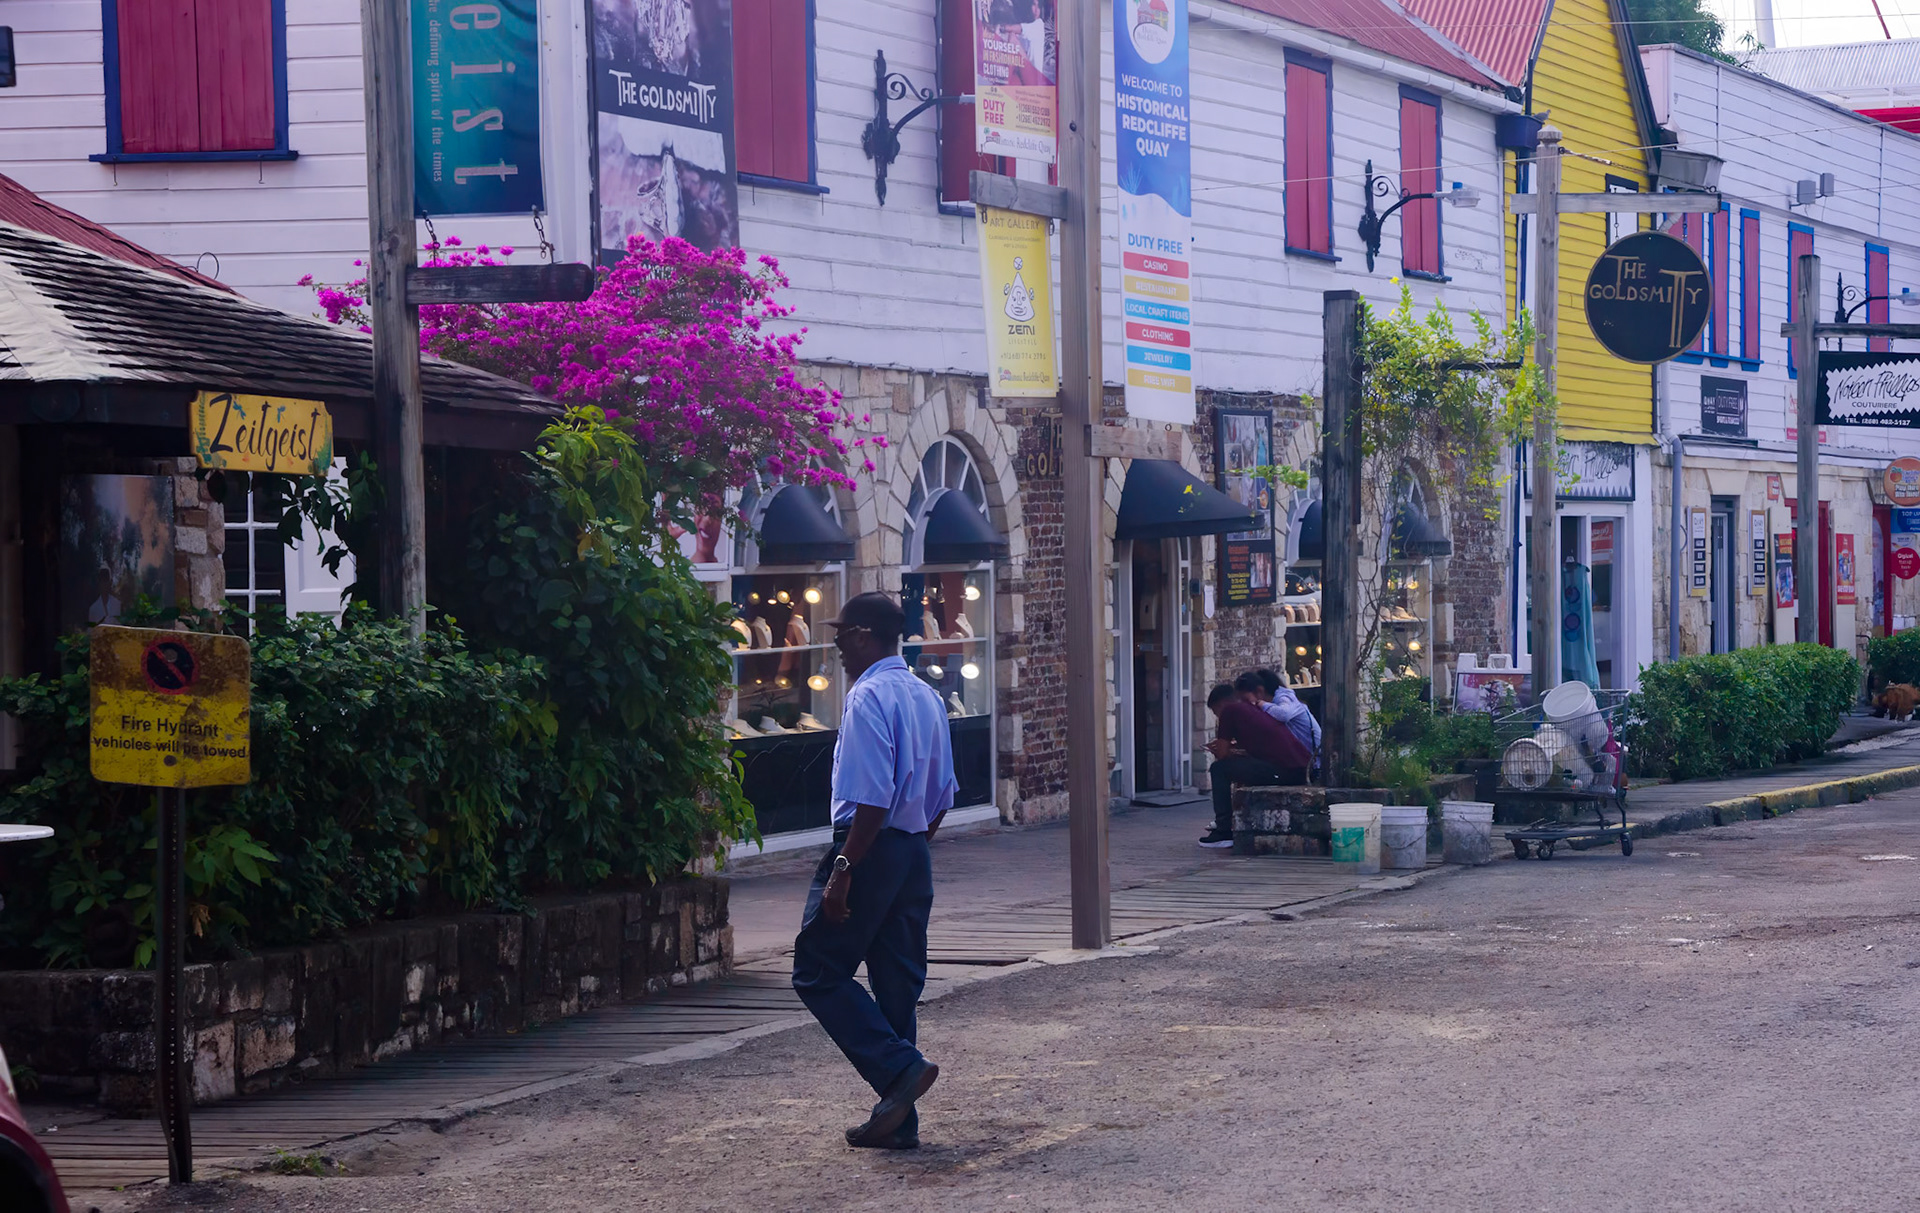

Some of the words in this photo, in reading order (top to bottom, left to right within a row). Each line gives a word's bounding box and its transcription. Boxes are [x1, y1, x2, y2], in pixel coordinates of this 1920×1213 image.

[427, 20, 441, 66] defining
[983, 38, 1020, 54] YOURSELF
[983, 62, 1009, 78] CLOTHING
[428, 72, 443, 103] spirit
[450, 4, 519, 185] eist
[1121, 73, 1168, 95] WELCOME
[1169, 84, 1182, 97] TO
[608, 69, 637, 106] THE
[639, 81, 717, 123] GOLDSMITTY
[983, 99, 1005, 112] DUTY
[432, 110, 443, 120] of
[1117, 92, 1188, 122] HISTORICAL
[984, 112, 1004, 125] FREE
[1122, 113, 1186, 141] REDCLIFFE
[432, 127, 444, 145] the
[1136, 137, 1169, 157] QUAY
[433, 152, 445, 182] times
[989, 217, 1004, 228] ART
[1007, 218, 1040, 230] GALLERY
[1128, 232, 1154, 249] DUTY
[1157, 238, 1183, 254] FREE
[1143, 259, 1168, 272] CASINO
[1604, 254, 1647, 286] THE
[1135, 281, 1177, 296] RESTAURANT
[1126, 302, 1147, 315] LOCAL
[1147, 306, 1168, 318] CRAFT
[1169, 310, 1189, 321] ITEMS
[1589, 268, 1704, 348] GOLDSMITTY
[1008, 324, 1036, 336] ZEMI
[1142, 328, 1175, 342] CLOTHING
[1144, 351, 1173, 364] JEWELRY
[1144, 374, 1160, 385] FREE
[209, 393, 321, 472] Zeitgeist
[121, 715, 150, 732] Fire
[157, 718, 219, 737] Hydrant
[95, 736, 151, 751] vehicles
[156, 742, 179, 753] will
[203, 745, 247, 759] towed
